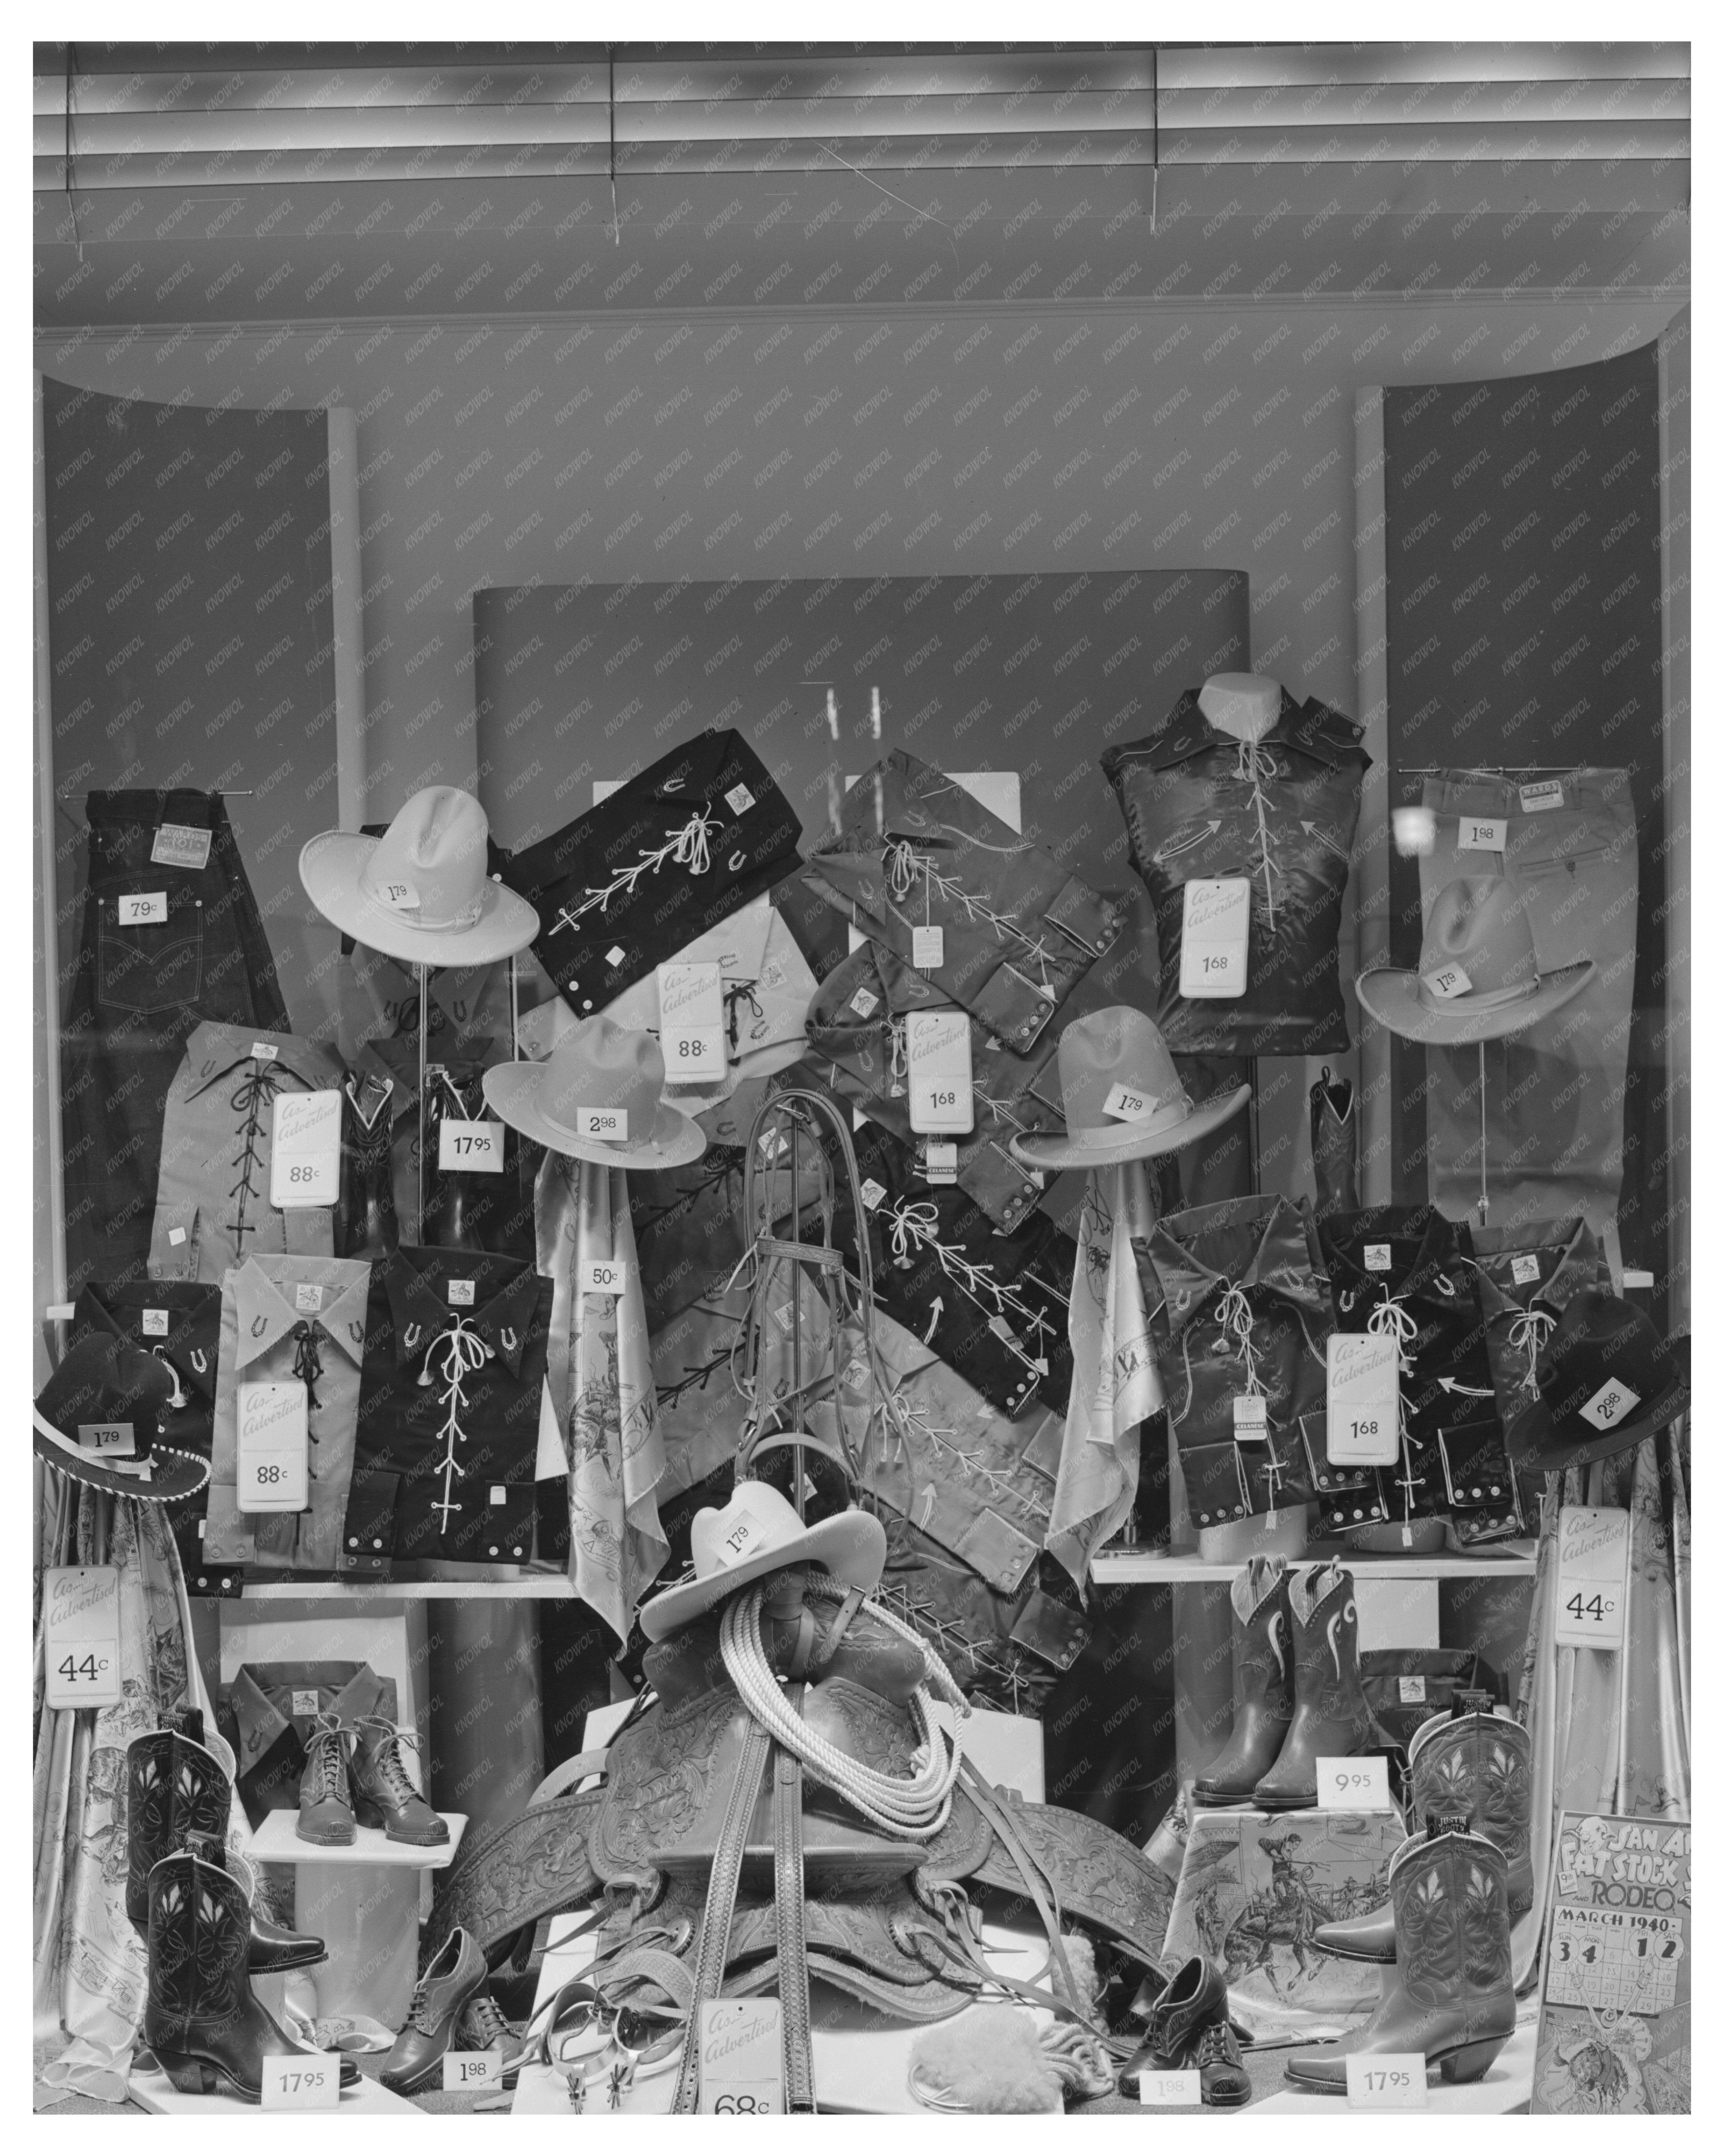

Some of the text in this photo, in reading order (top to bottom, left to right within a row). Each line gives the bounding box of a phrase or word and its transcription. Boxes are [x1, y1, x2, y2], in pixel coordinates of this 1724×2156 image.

[1523, 783, 1557, 795] WARDS
[1473, 827, 1493, 842] 198
[131, 902, 157, 916] 79c
[1203, 957, 1227, 972] 168
[679, 1040, 707, 1057] 88c
[930, 1092, 955, 1108] 168
[454, 1137, 490, 1154] 1795
[290, 1167, 319, 1182] 88c
[593, 1269, 617, 1284] 50c
[1351, 1422, 1377, 1438] 168
[258, 1466, 287, 1483] 88c
[1567, 1593, 1614, 1621] 44c
[59, 1655, 108, 1681] 44c
[1336, 1774, 1370, 1791] 995
[1438, 1816, 1466, 1827] JUSTIN
[1607, 1824, 1658, 1852] SAN
[1561, 1842, 1611, 1878] FAT
[1612, 1852, 1679, 1888] STOCK
[1561, 1873, 1573, 1883] 9th
[1591, 1880, 1676, 1912] RODEO
[1558, 1908, 1623, 1925] MARCH
[1559, 1942, 1570, 1961] 3
[1582, 1945, 1596, 1963] 4
[1637, 1938, 1647, 1957] 1
[1661, 1940, 1677, 1958] 2
[461, 2063, 486, 2081] 198
[280, 2073, 324, 2092] 1795
[1158, 2080, 1185, 2096] 198
[1364, 2072, 1409, 2090] 1795
